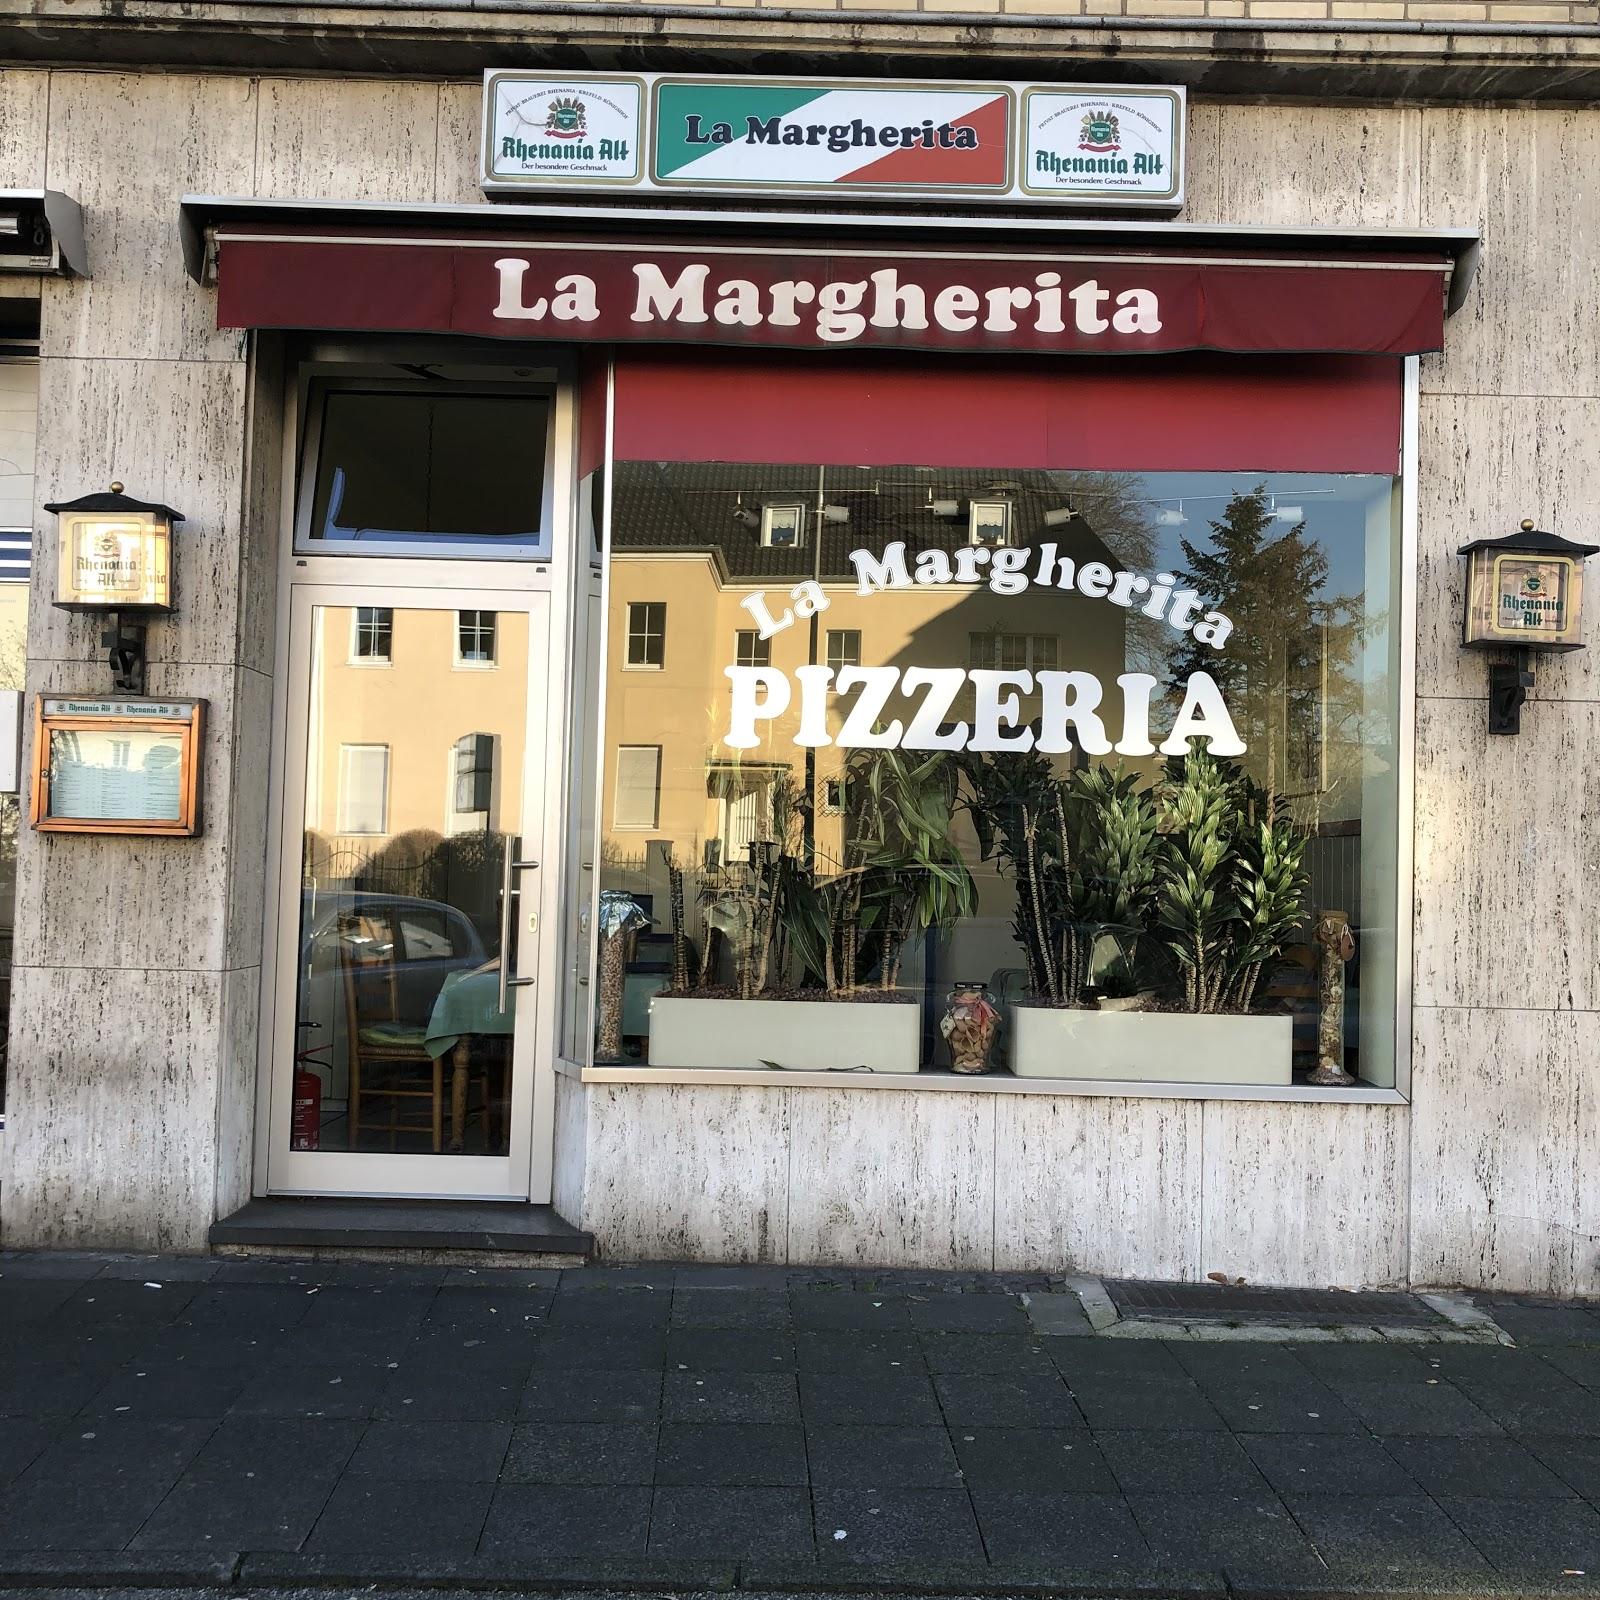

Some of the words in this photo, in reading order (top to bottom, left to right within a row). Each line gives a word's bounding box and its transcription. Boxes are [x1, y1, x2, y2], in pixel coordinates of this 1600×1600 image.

[684, 114, 735, 144] La
[745, 115, 979, 153] Margherita
[502, 136, 595, 162] Rhenania
[599, 138, 630, 161] Alt
[521, 162, 534, 170] Der
[535, 162, 569, 171] besondere
[570, 163, 608, 172] Geschmack
[1035, 149, 1129, 176] Rhenania
[1133, 152, 1164, 175] Alt
[1055, 176, 1068, 184] Der
[1069, 176, 1103, 185] besondere
[1104, 177, 1142, 186] Geschmack
[493, 258, 600, 322] La
[630, 263, 1163, 342] Margherita
[740, 579, 831, 641] La
[848, 541, 1234, 650] Margherita
[1502, 593, 1564, 612] Rhenania
[1524, 610, 1543, 626] Alt
[723, 664, 1248, 757] PIZZERIA
